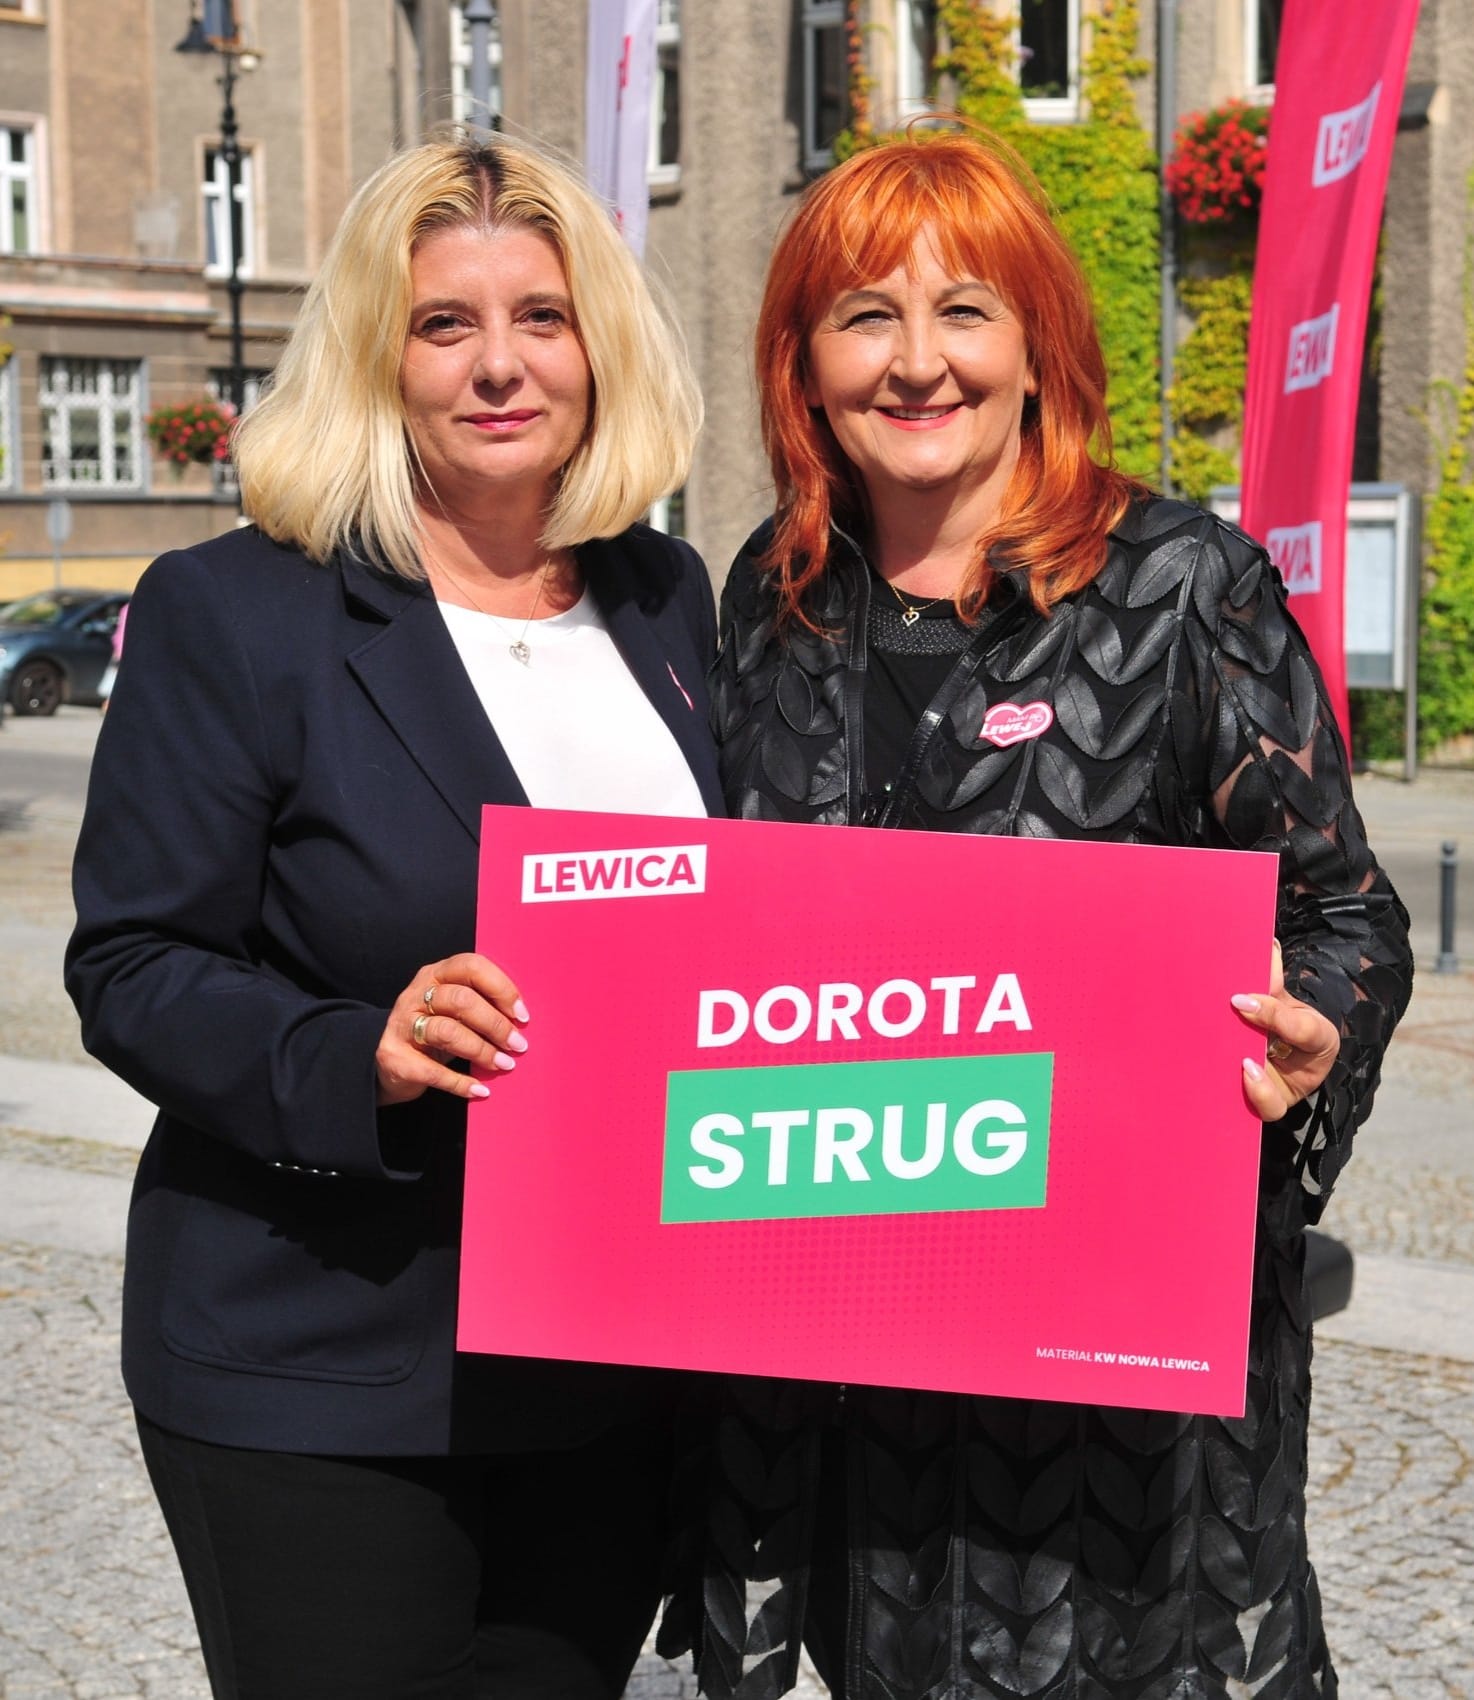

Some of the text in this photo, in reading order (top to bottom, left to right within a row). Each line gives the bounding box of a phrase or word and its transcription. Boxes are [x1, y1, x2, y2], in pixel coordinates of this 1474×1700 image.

[534, 853, 696, 894] LEWICA
[697, 973, 1033, 1049] DOROTA
[688, 1099, 1028, 1189] STRUG
[1036, 1347, 1210, 1372] MATERIAŁ KW NOWA LEWICA
